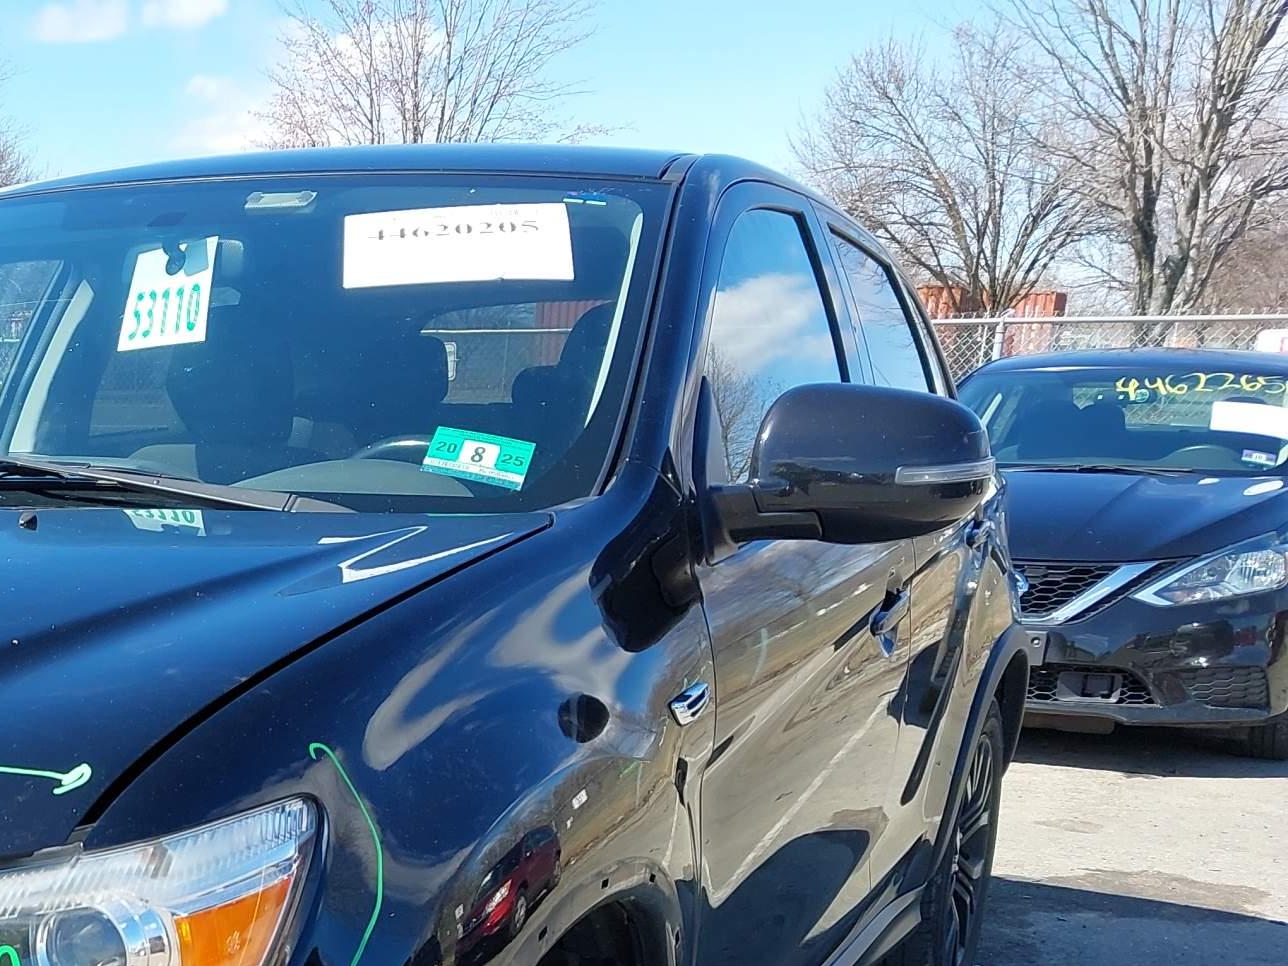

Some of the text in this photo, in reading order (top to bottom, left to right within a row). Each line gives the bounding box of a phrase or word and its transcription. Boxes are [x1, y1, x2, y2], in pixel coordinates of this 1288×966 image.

[128, 283, 201, 341] 53110
[435, 441, 525, 467] 20 8 25
